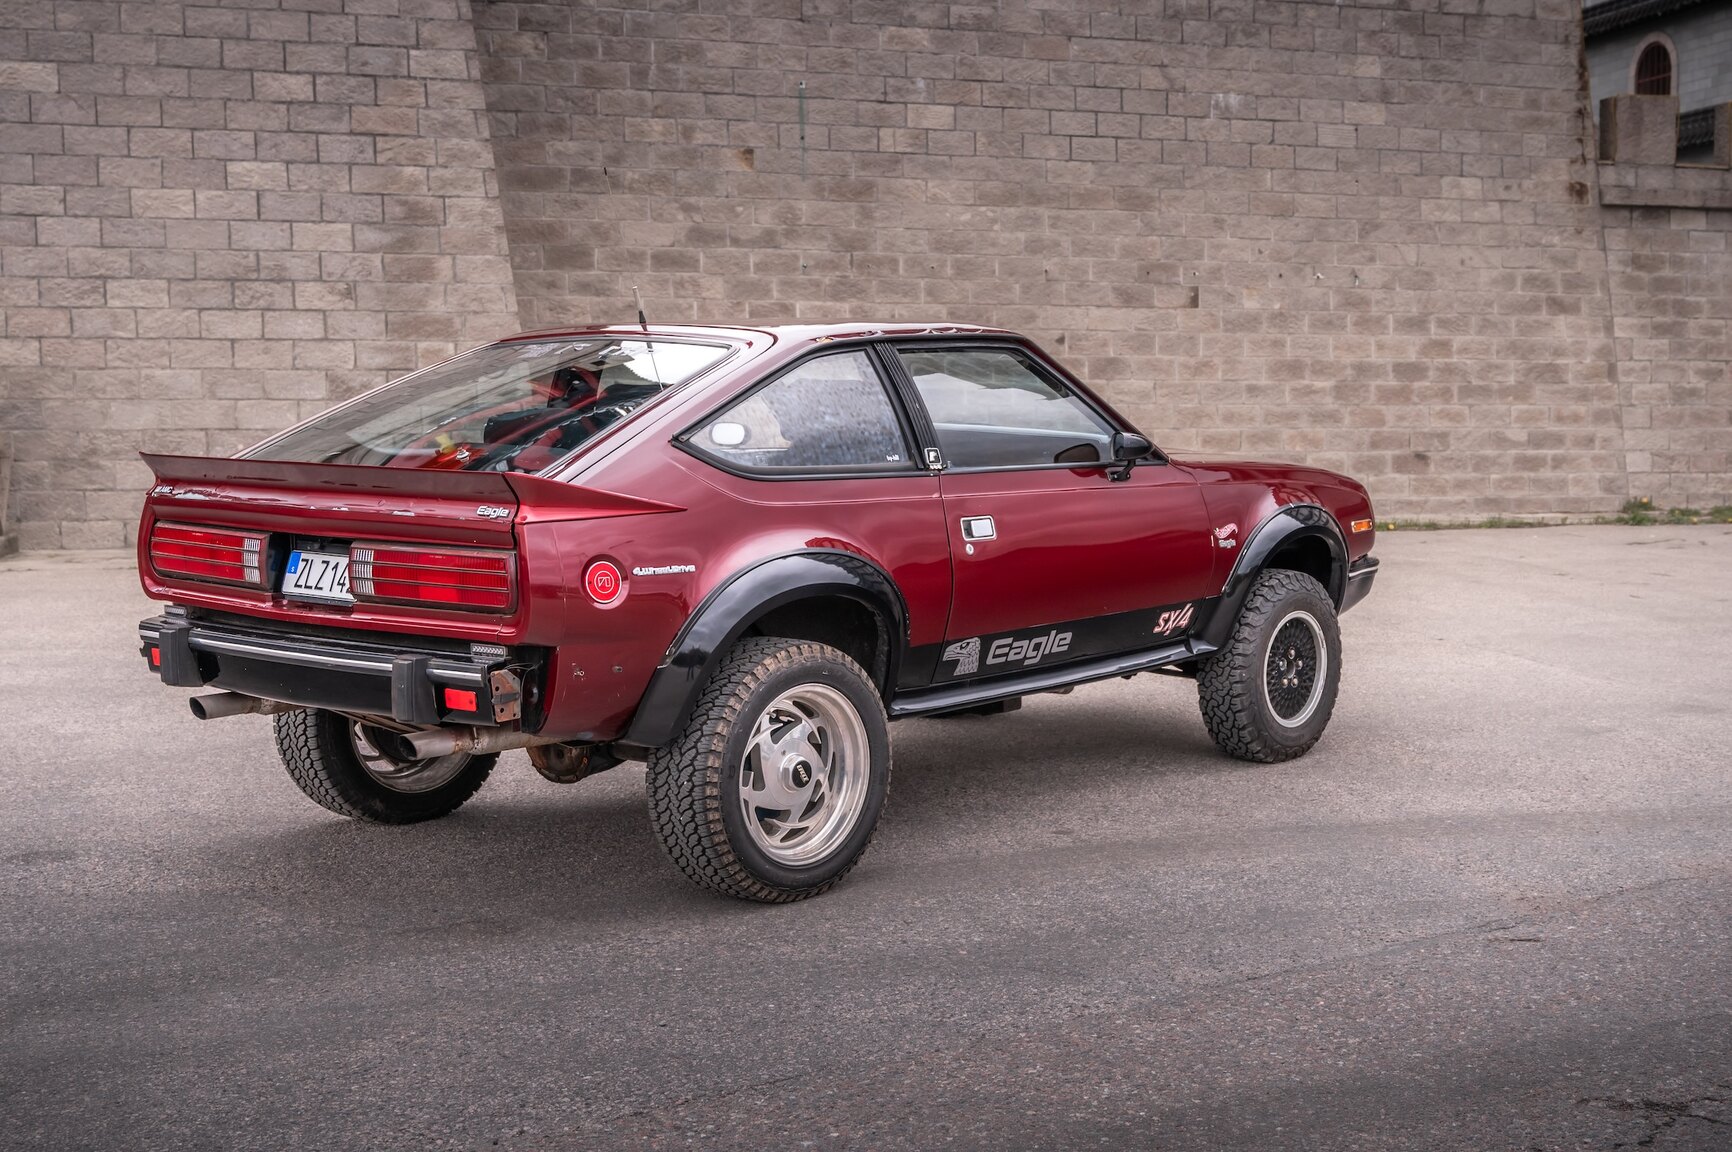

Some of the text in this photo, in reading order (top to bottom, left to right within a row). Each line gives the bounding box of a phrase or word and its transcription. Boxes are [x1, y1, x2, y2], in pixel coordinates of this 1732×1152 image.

[476, 505, 510, 519] Eagle
[294, 558, 351, 594] ZLZ14
[985, 629, 1073, 666] Eagle
